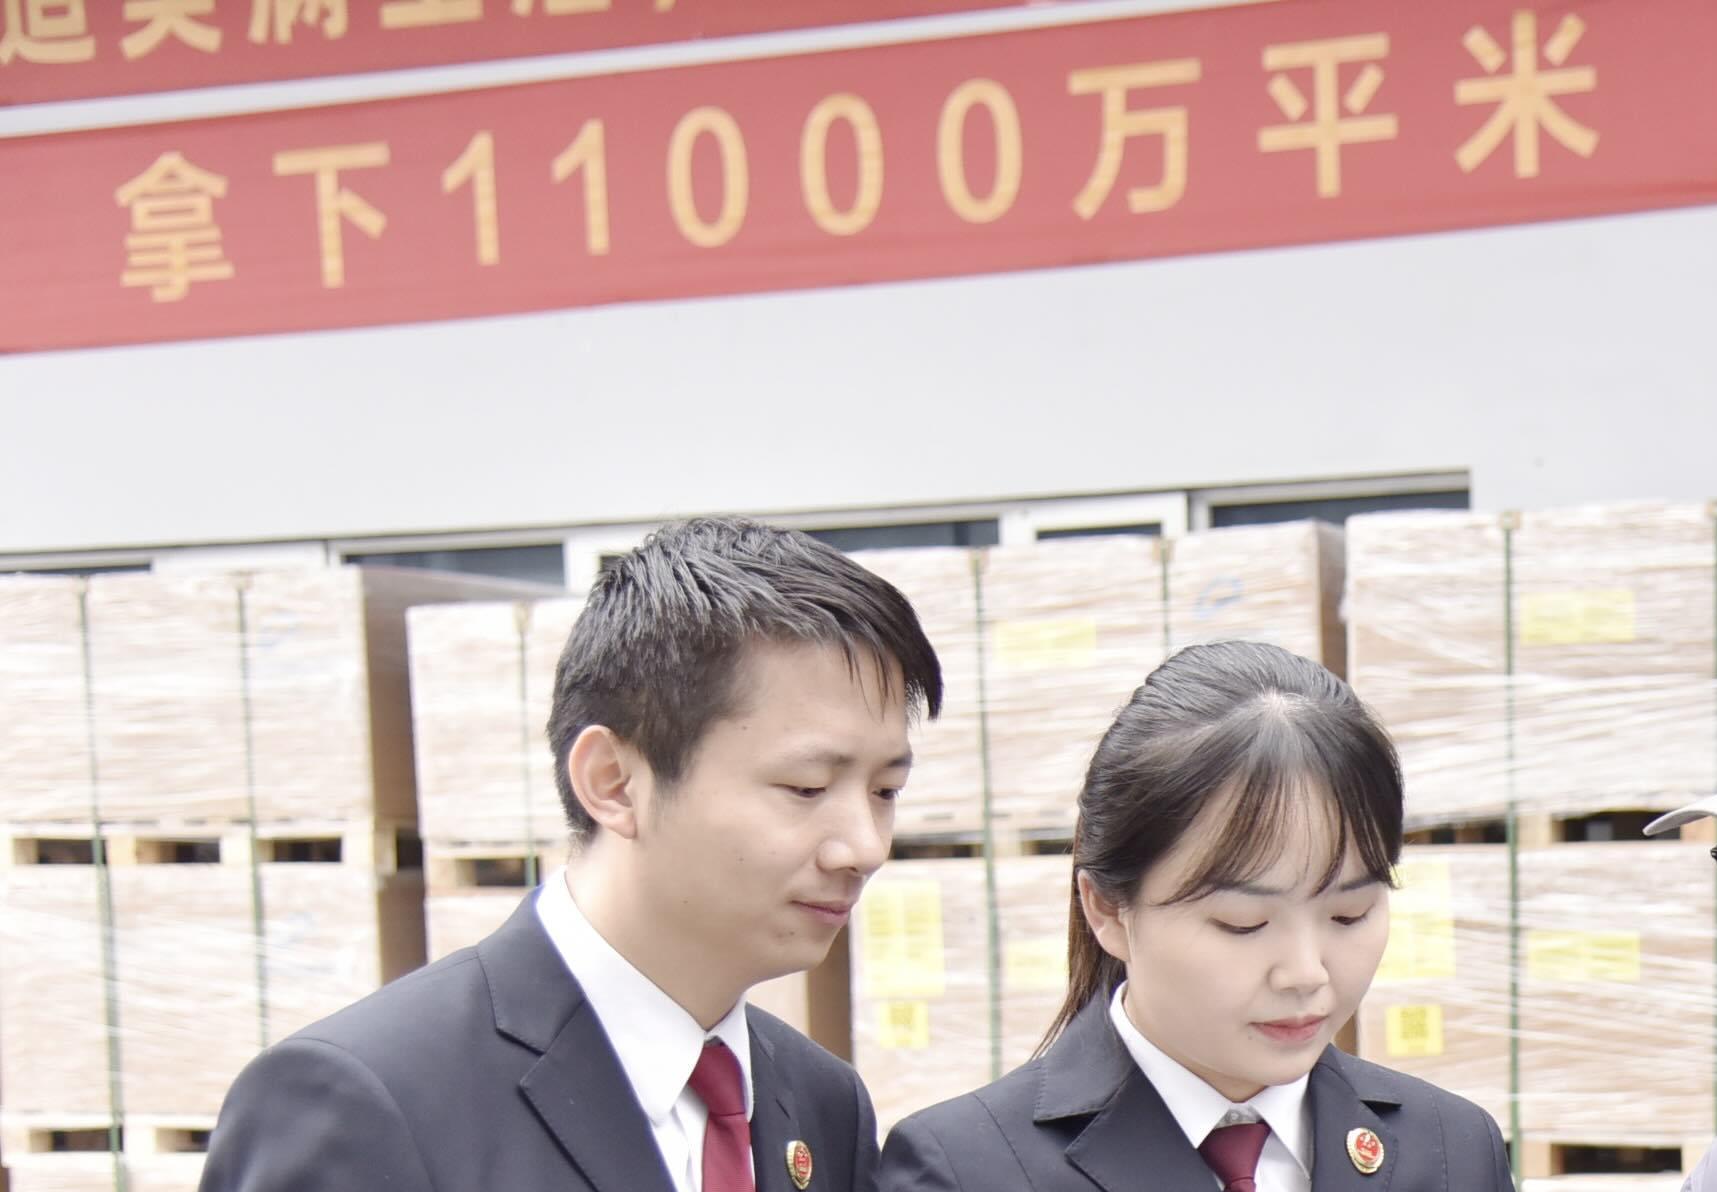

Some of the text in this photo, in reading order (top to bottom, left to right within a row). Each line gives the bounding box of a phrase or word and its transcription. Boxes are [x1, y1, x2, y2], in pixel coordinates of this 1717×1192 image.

[114, 10, 1599, 303] 拿下11000万平米
